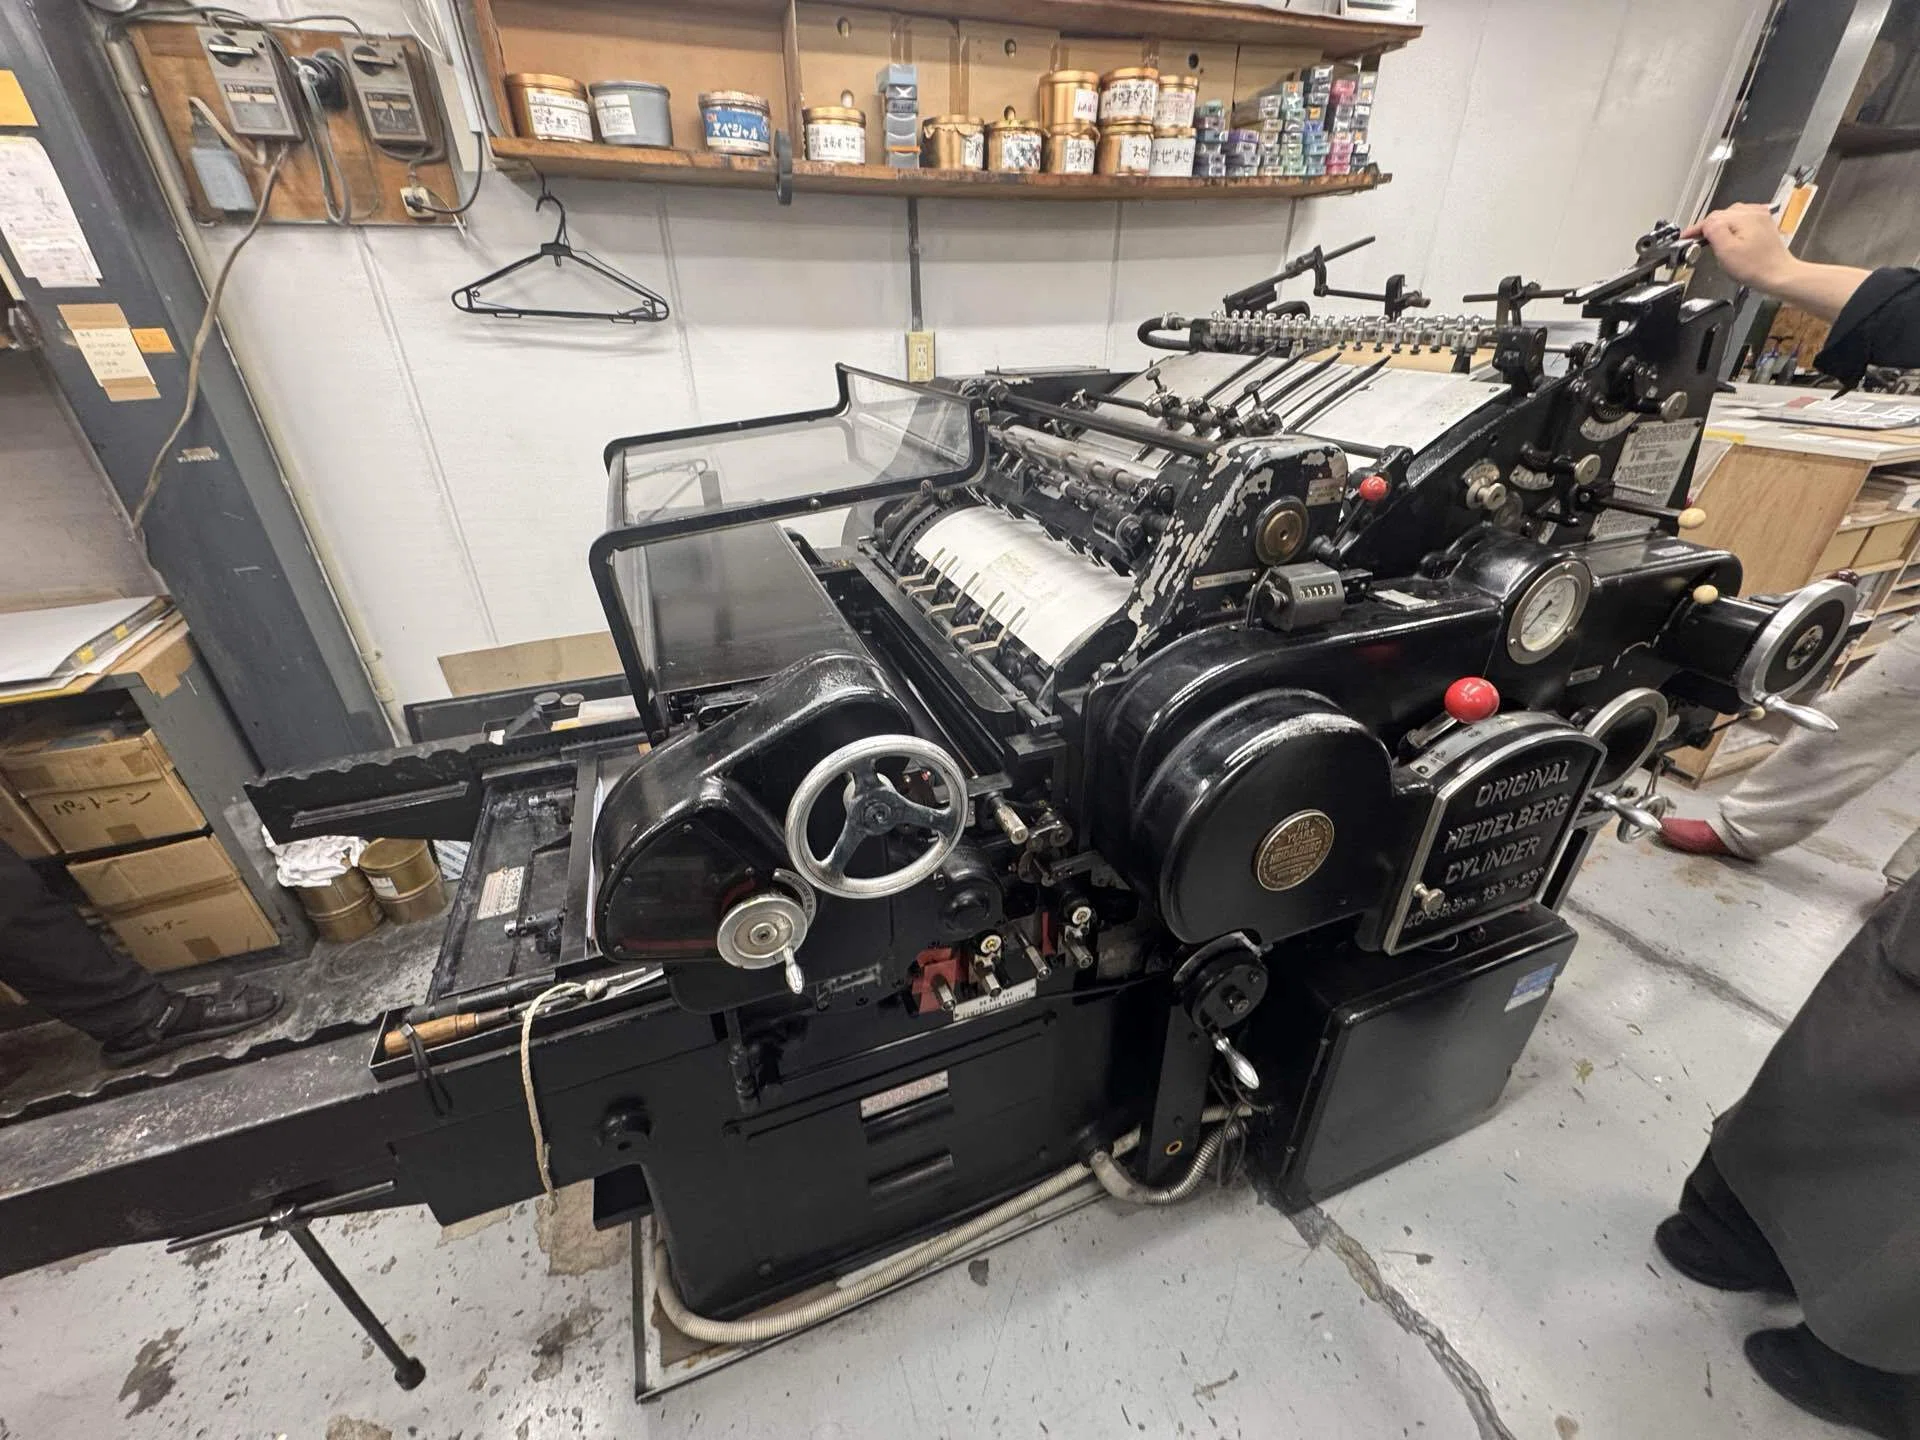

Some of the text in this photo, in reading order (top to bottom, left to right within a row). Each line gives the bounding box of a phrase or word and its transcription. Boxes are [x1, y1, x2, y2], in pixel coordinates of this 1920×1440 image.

[712, 122, 758, 140] スペシャル
[1474, 760, 1570, 808] ORIGINAL
[1287, 828, 1316, 844] YEARS
[1443, 795, 1571, 853] HEIDELBERG
[1444, 836, 1541, 885] CYLINDER
